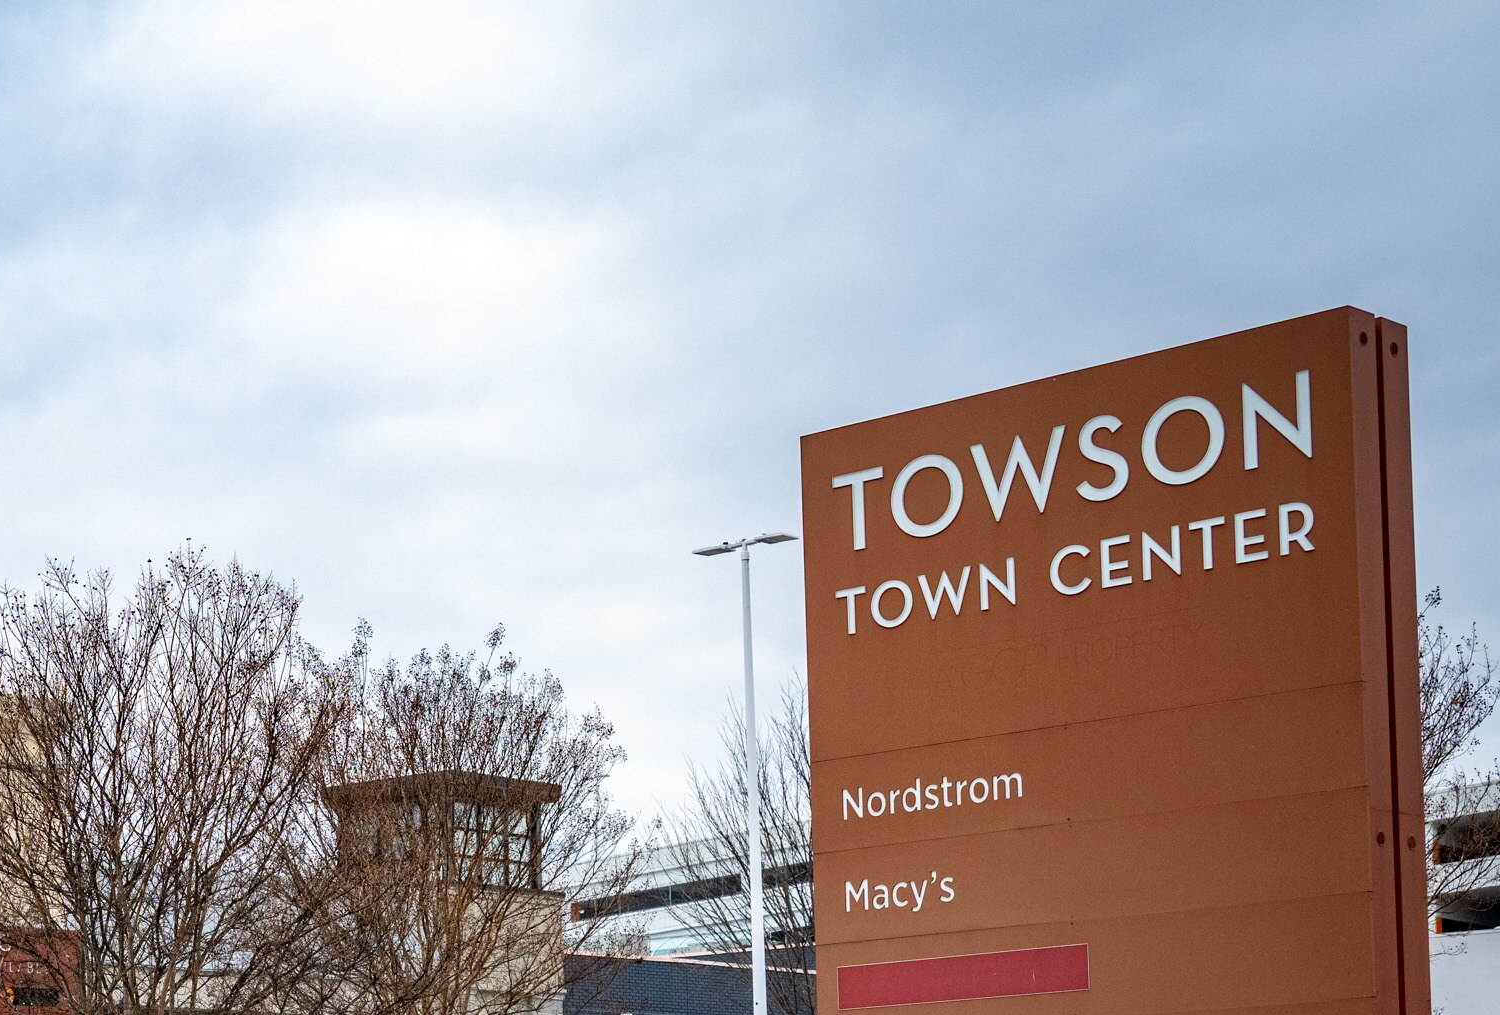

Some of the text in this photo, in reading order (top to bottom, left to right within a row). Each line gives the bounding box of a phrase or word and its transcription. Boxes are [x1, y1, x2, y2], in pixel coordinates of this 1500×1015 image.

[832, 369, 1313, 551] TOWSON
[835, 501, 1316, 635] TOWN CENTER
[841, 771, 1024, 821] Nordstrom
[844, 870, 956, 913] Macy's
